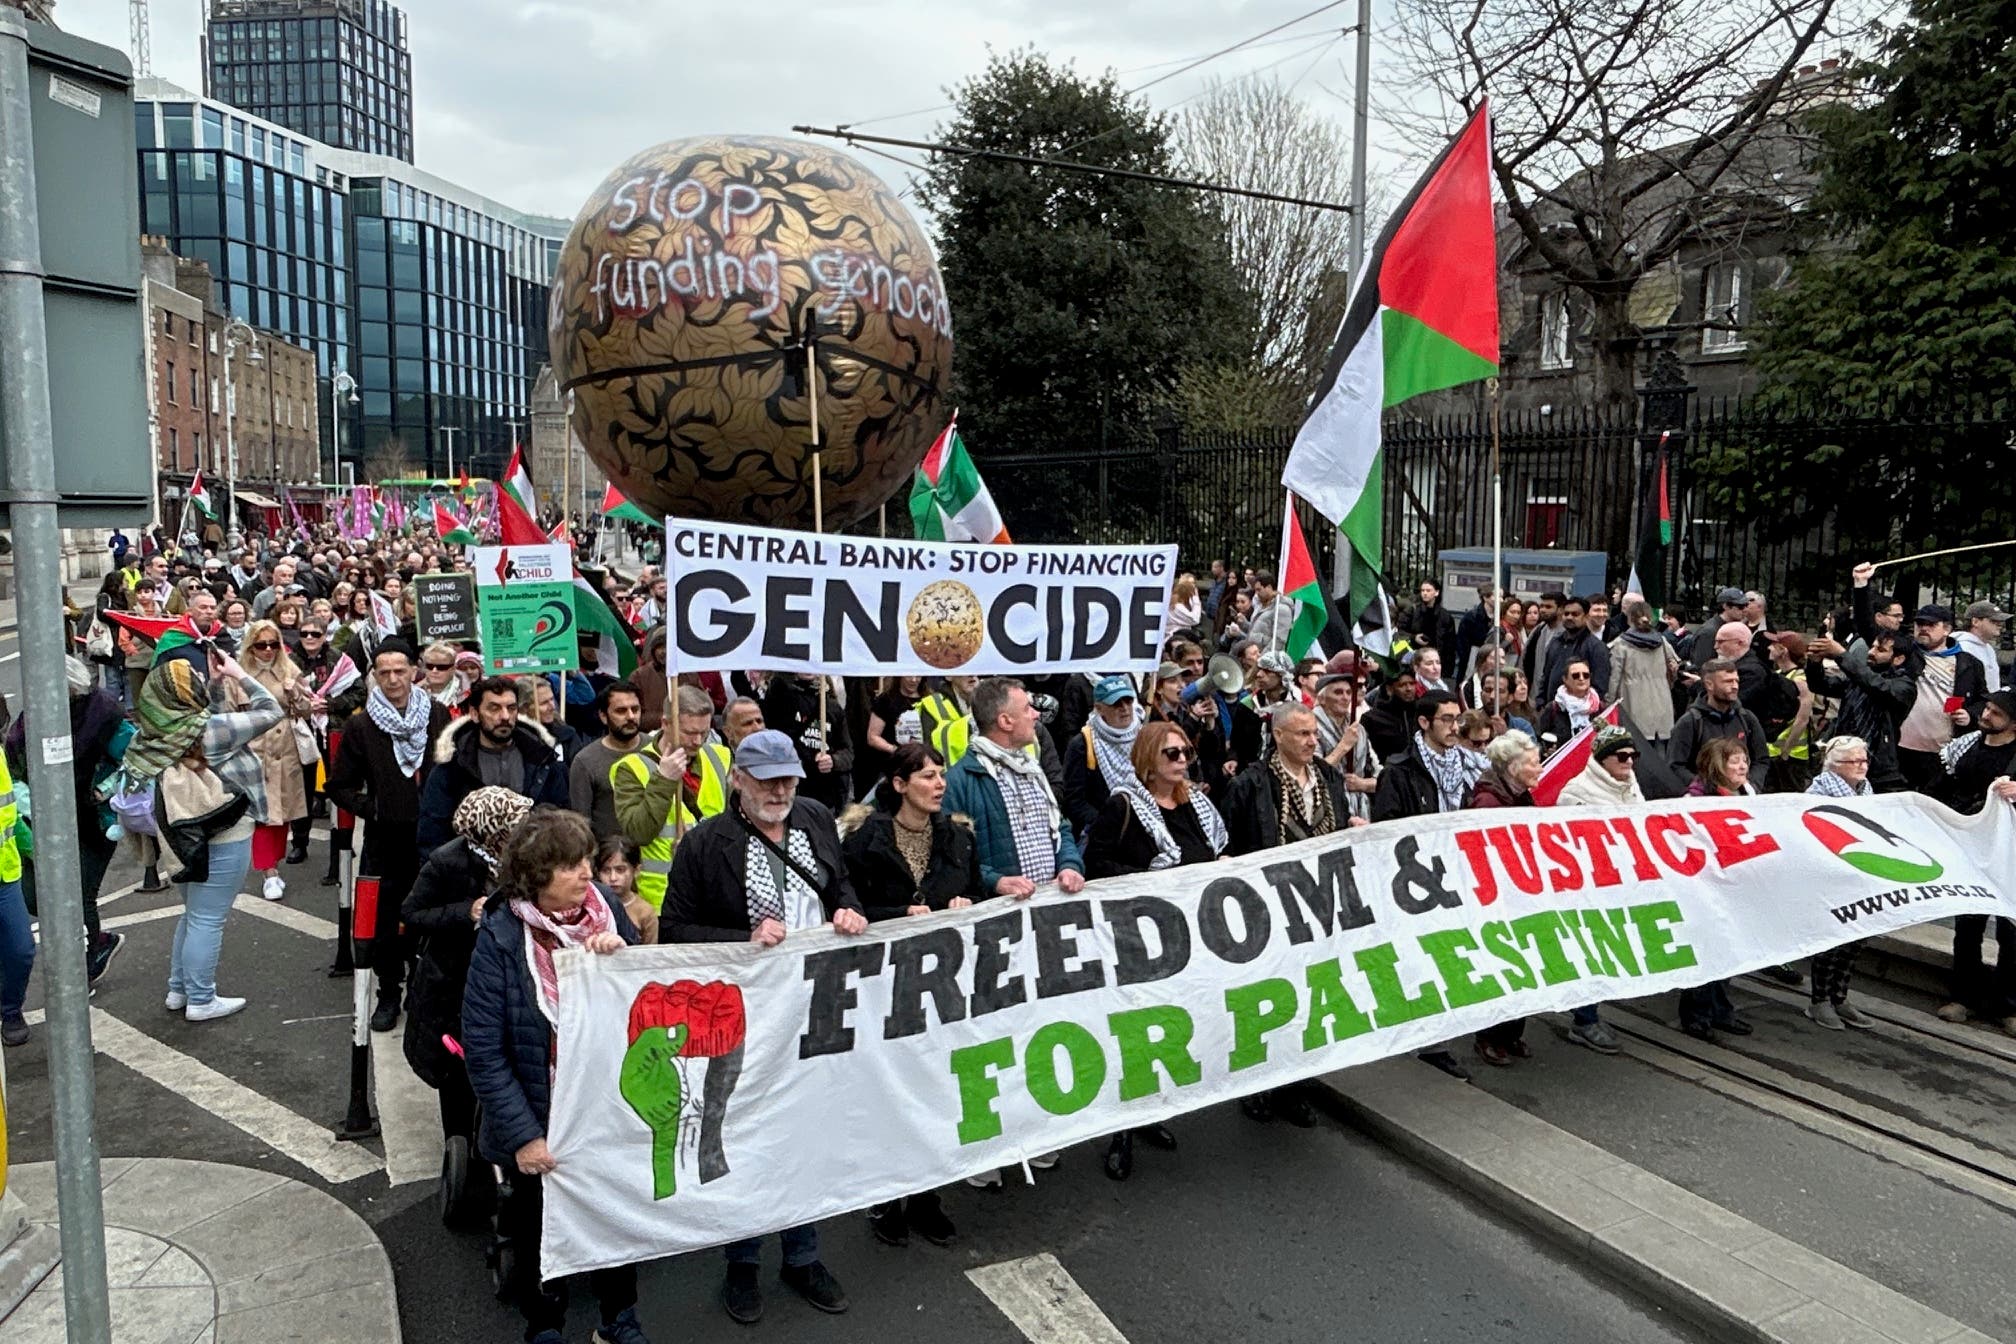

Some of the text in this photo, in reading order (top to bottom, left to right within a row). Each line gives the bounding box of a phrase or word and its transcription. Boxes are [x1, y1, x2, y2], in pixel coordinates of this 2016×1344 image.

[609, 171, 762, 236] stop
[590, 235, 780, 324] funding
[810, 249, 953, 340] genocid
[674, 530, 1166, 576] CENTRAL BANK: STOP FINANCING
[519, 568, 552, 578] CHILD
[429, 582, 456, 592] DOING
[422, 593, 461, 604] NOTHING
[505, 592, 539, 600] Another
[541, 590, 562, 598] Child
[433, 612, 458, 622] BEING
[428, 623, 465, 635] COMPLICIT
[799, 809, 1781, 1060] FREEDOM & JUSTICE
[950, 901, 1698, 1146] FOR PALESTINE
